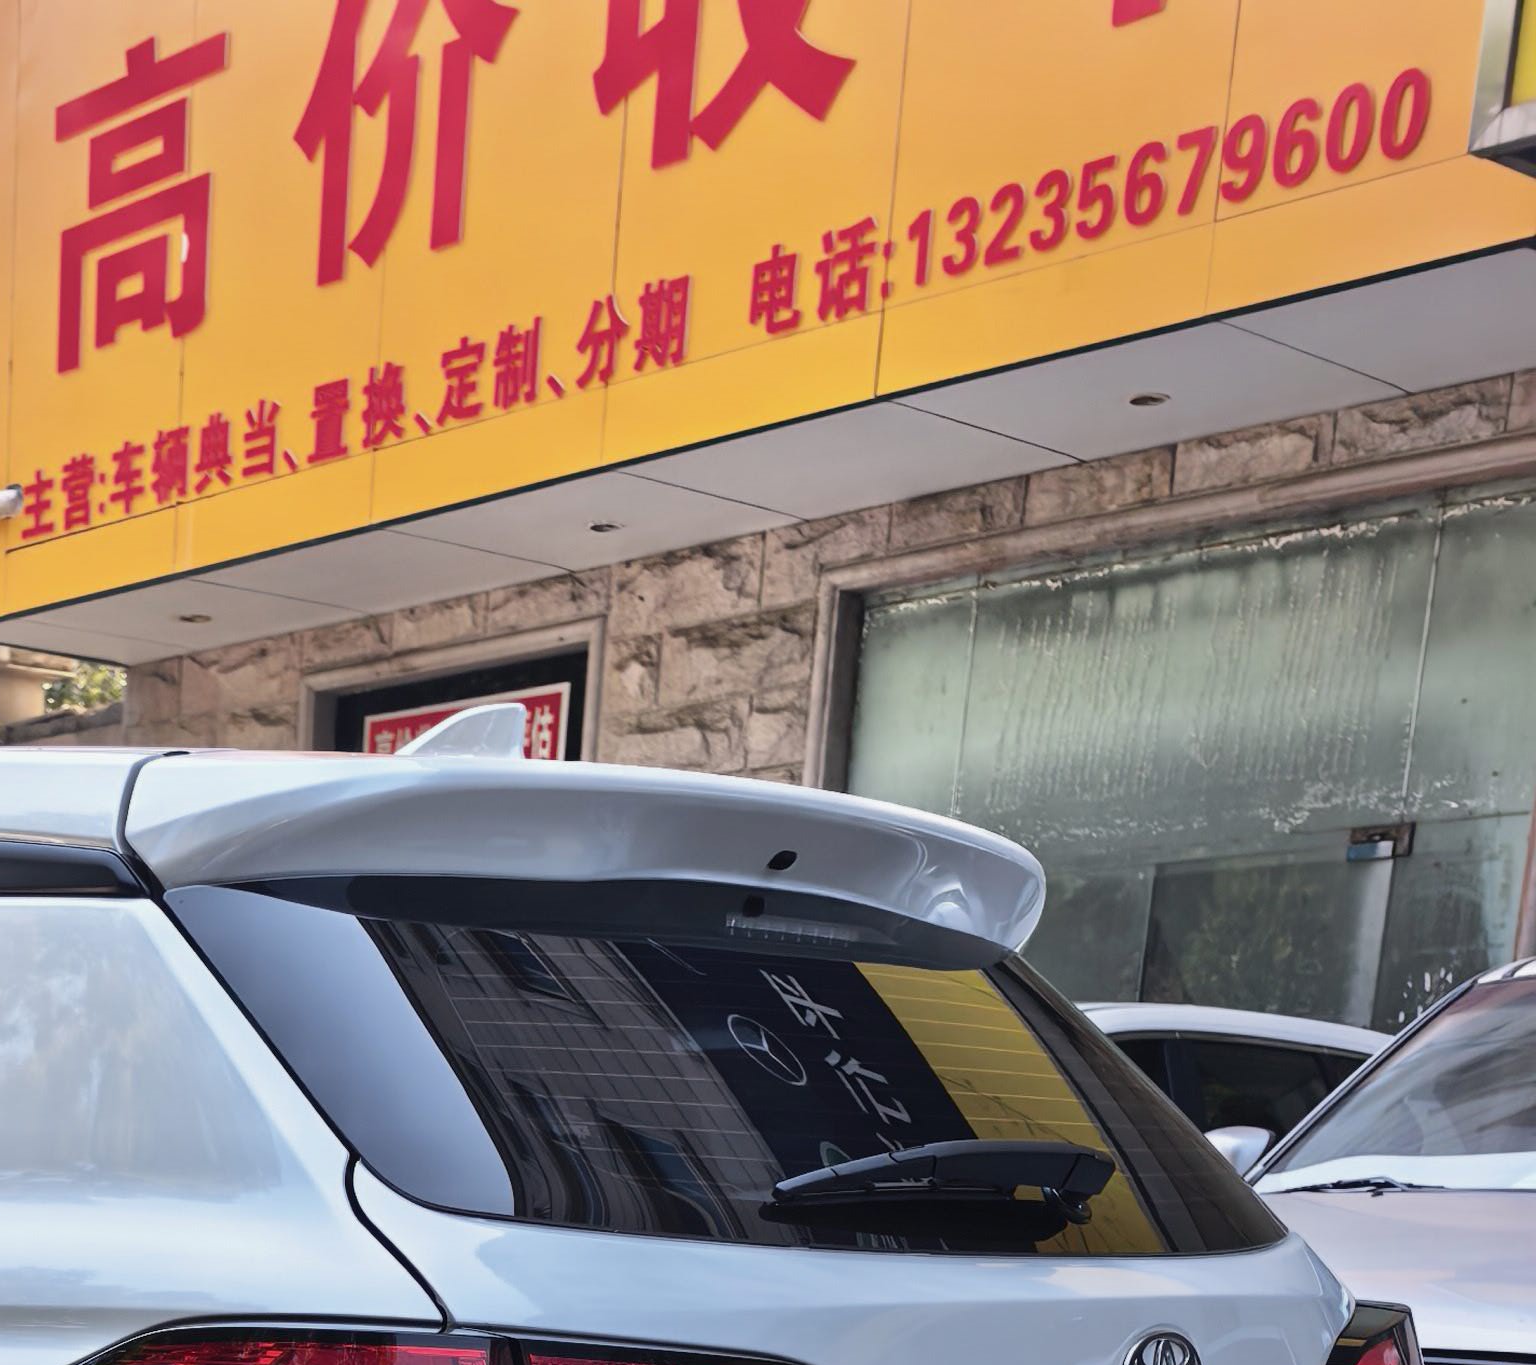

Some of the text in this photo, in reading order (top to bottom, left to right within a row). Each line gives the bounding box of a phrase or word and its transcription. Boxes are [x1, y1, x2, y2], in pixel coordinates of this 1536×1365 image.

[56, 0, 1166, 375] 高价收
[747, 67, 1431, 335] 电话:13235679600
